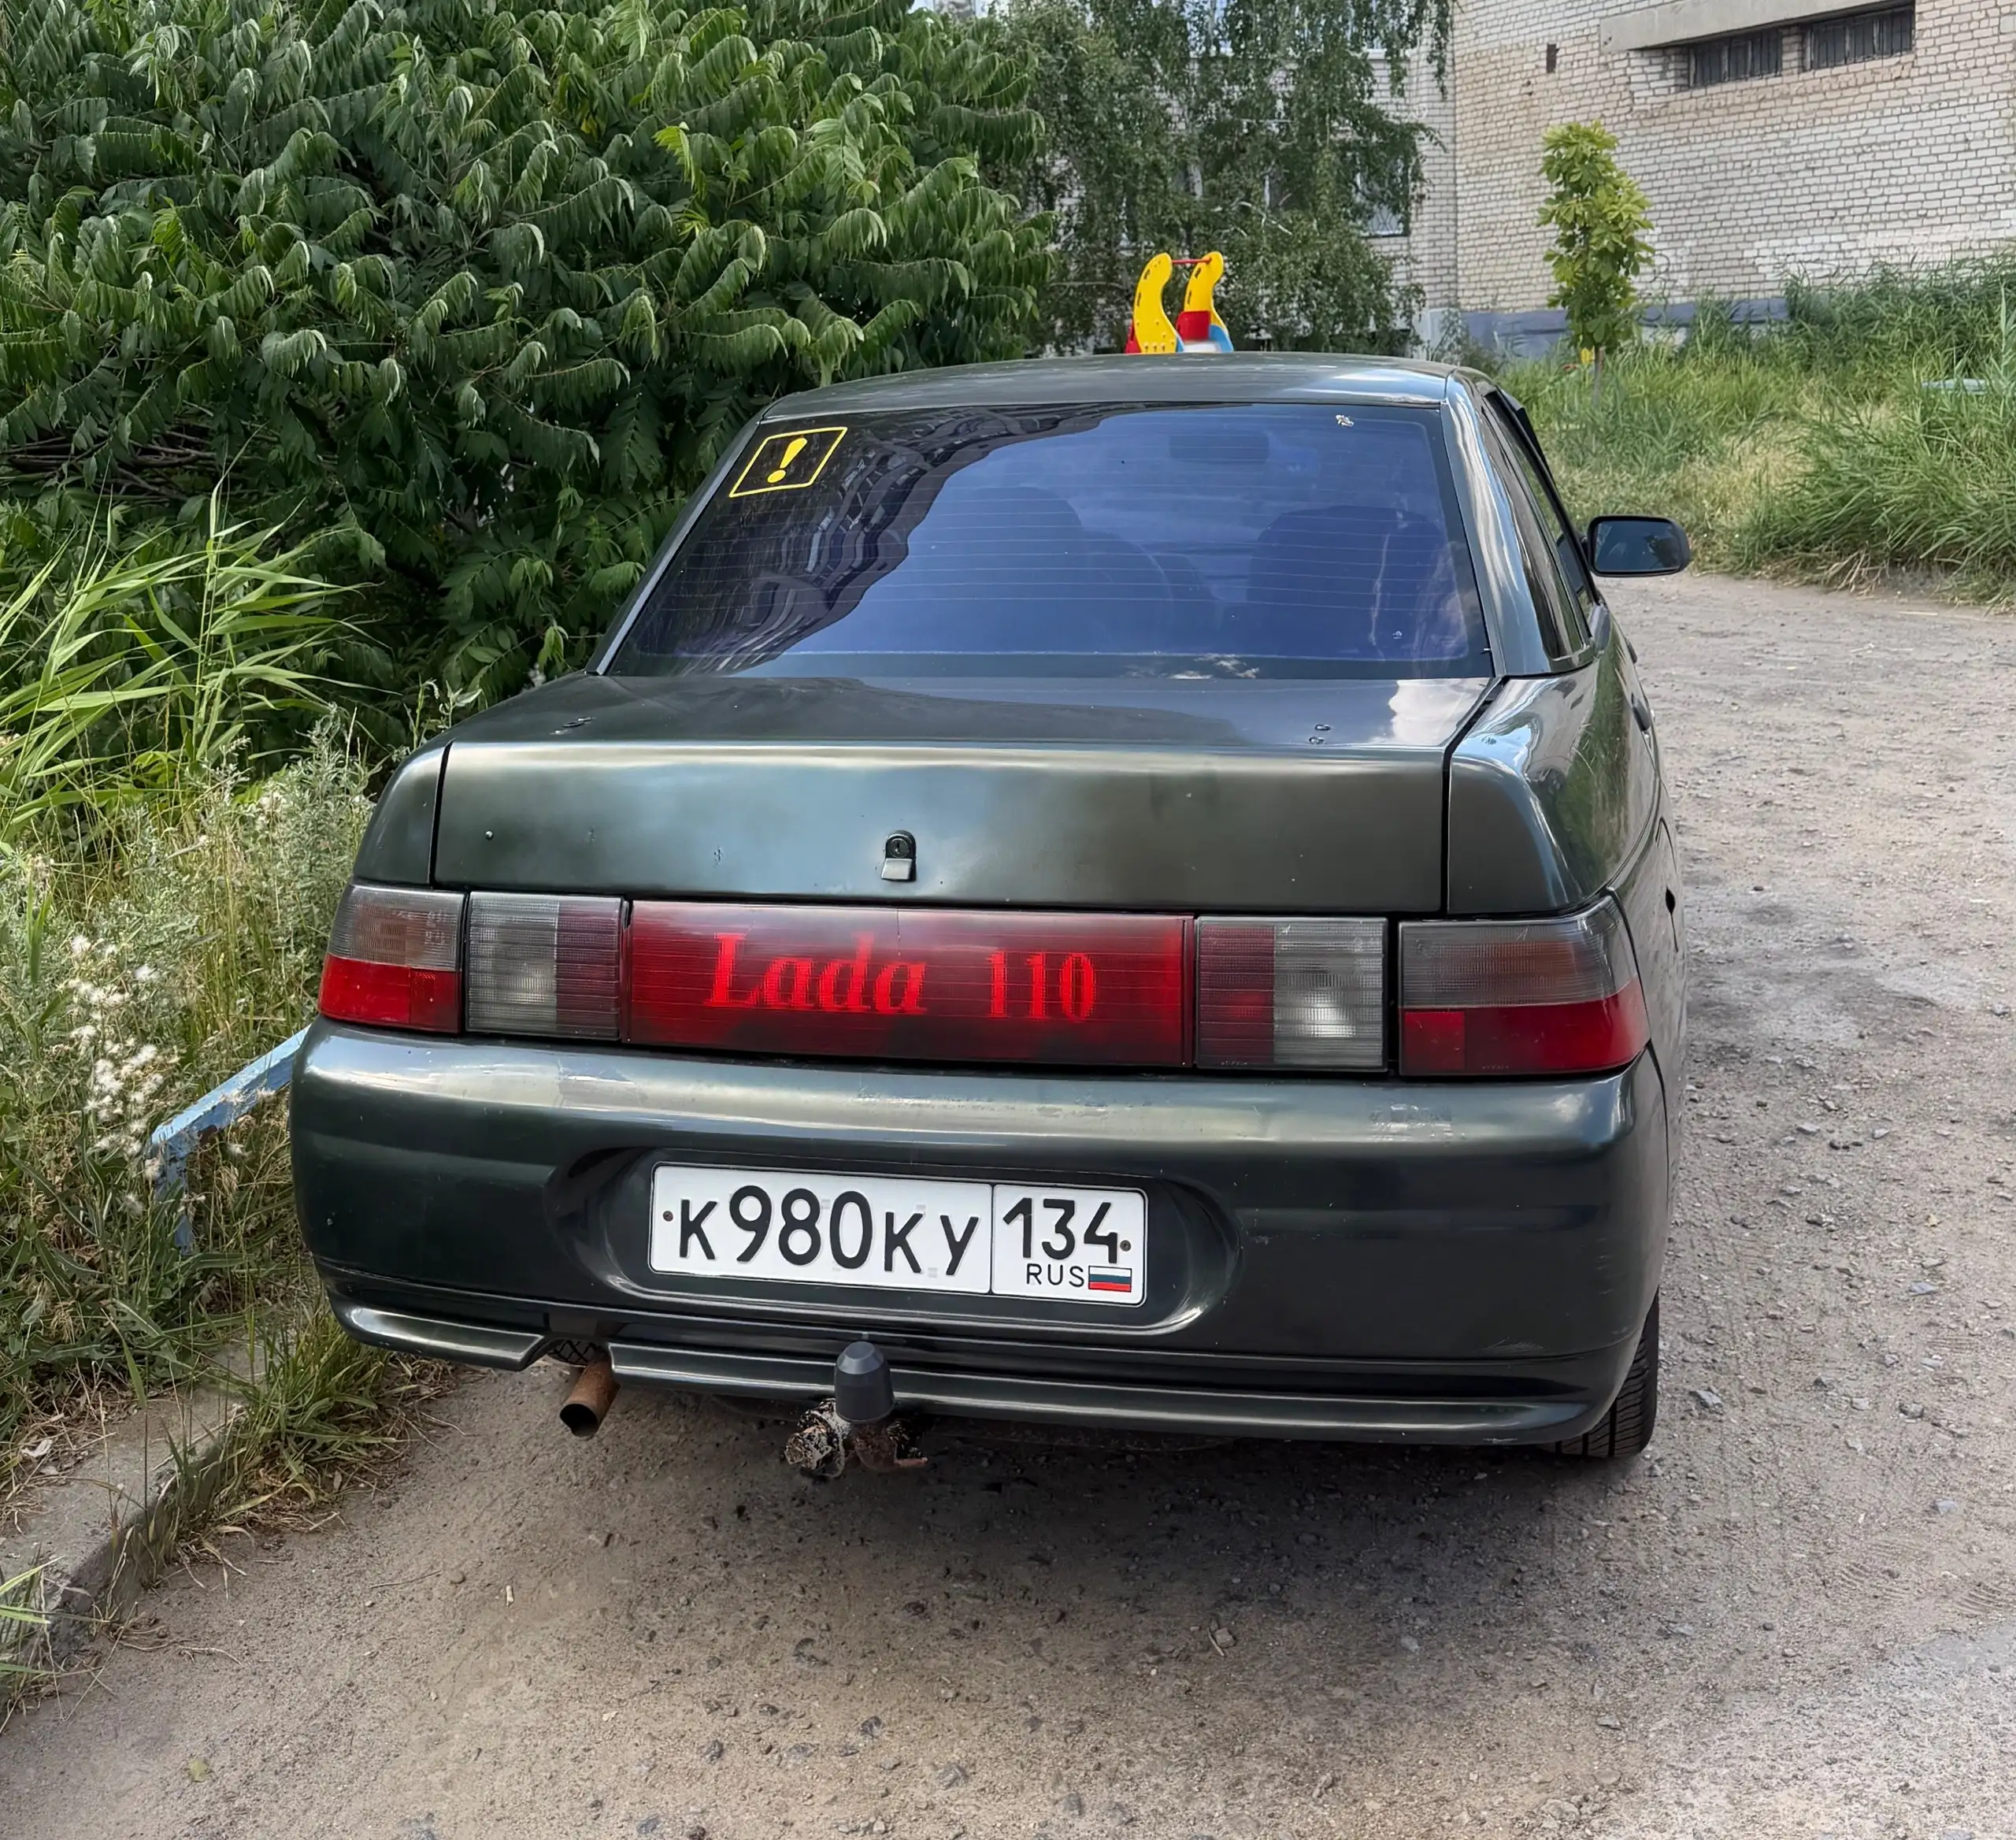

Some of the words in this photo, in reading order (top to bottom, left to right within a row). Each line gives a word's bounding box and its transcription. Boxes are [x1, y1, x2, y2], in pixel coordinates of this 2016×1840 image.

[706, 932, 927, 1015] Lada
[987, 952, 1097, 1022] 110
[1002, 1197, 1119, 1264] 134
[1025, 1263, 1084, 1288] RUS
